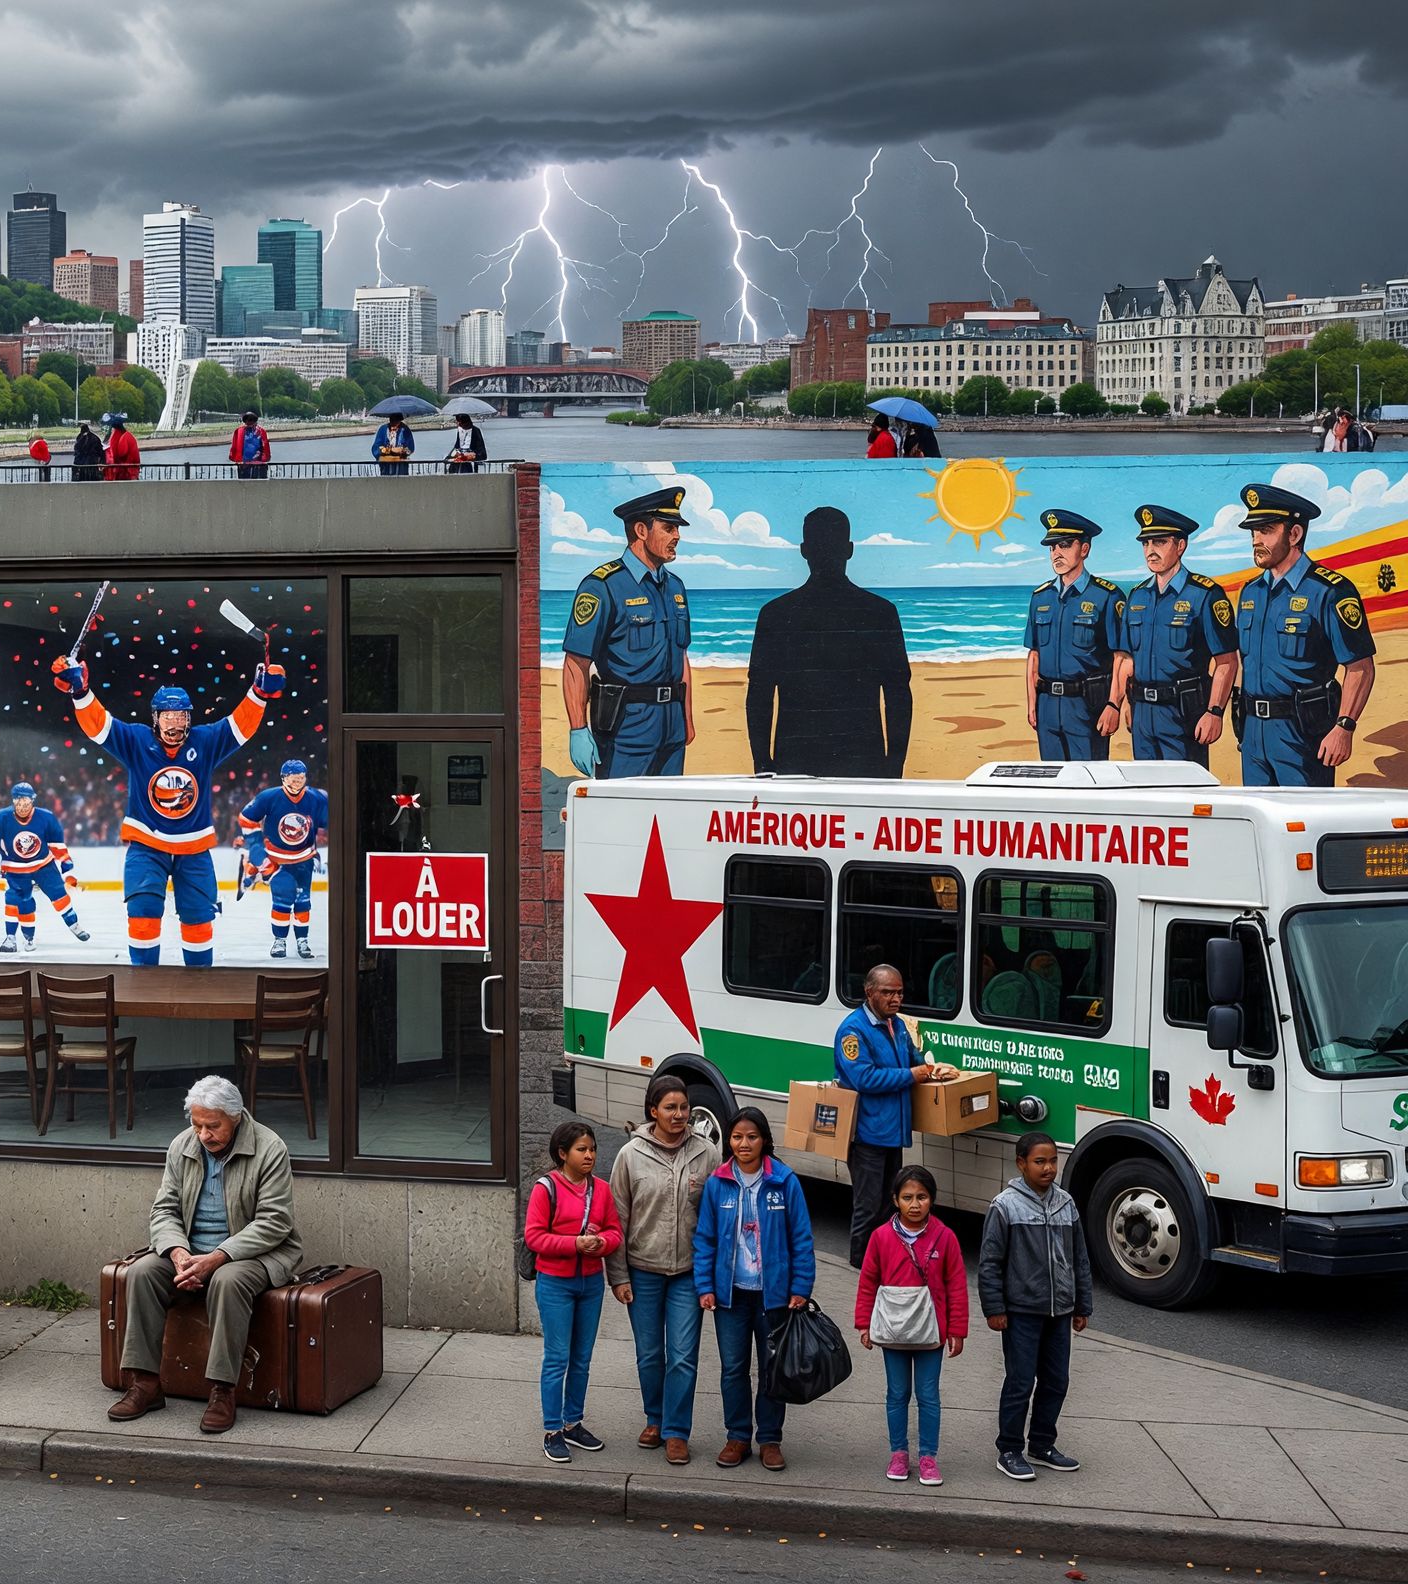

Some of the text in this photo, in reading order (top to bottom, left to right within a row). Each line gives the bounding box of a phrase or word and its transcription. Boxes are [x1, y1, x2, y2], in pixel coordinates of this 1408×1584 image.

[706, 796, 1189, 867] AMÉRIQUE - AIDE HUMANITAIRE
[415, 857, 440, 898] À
[373, 902, 481, 939] LOUER
